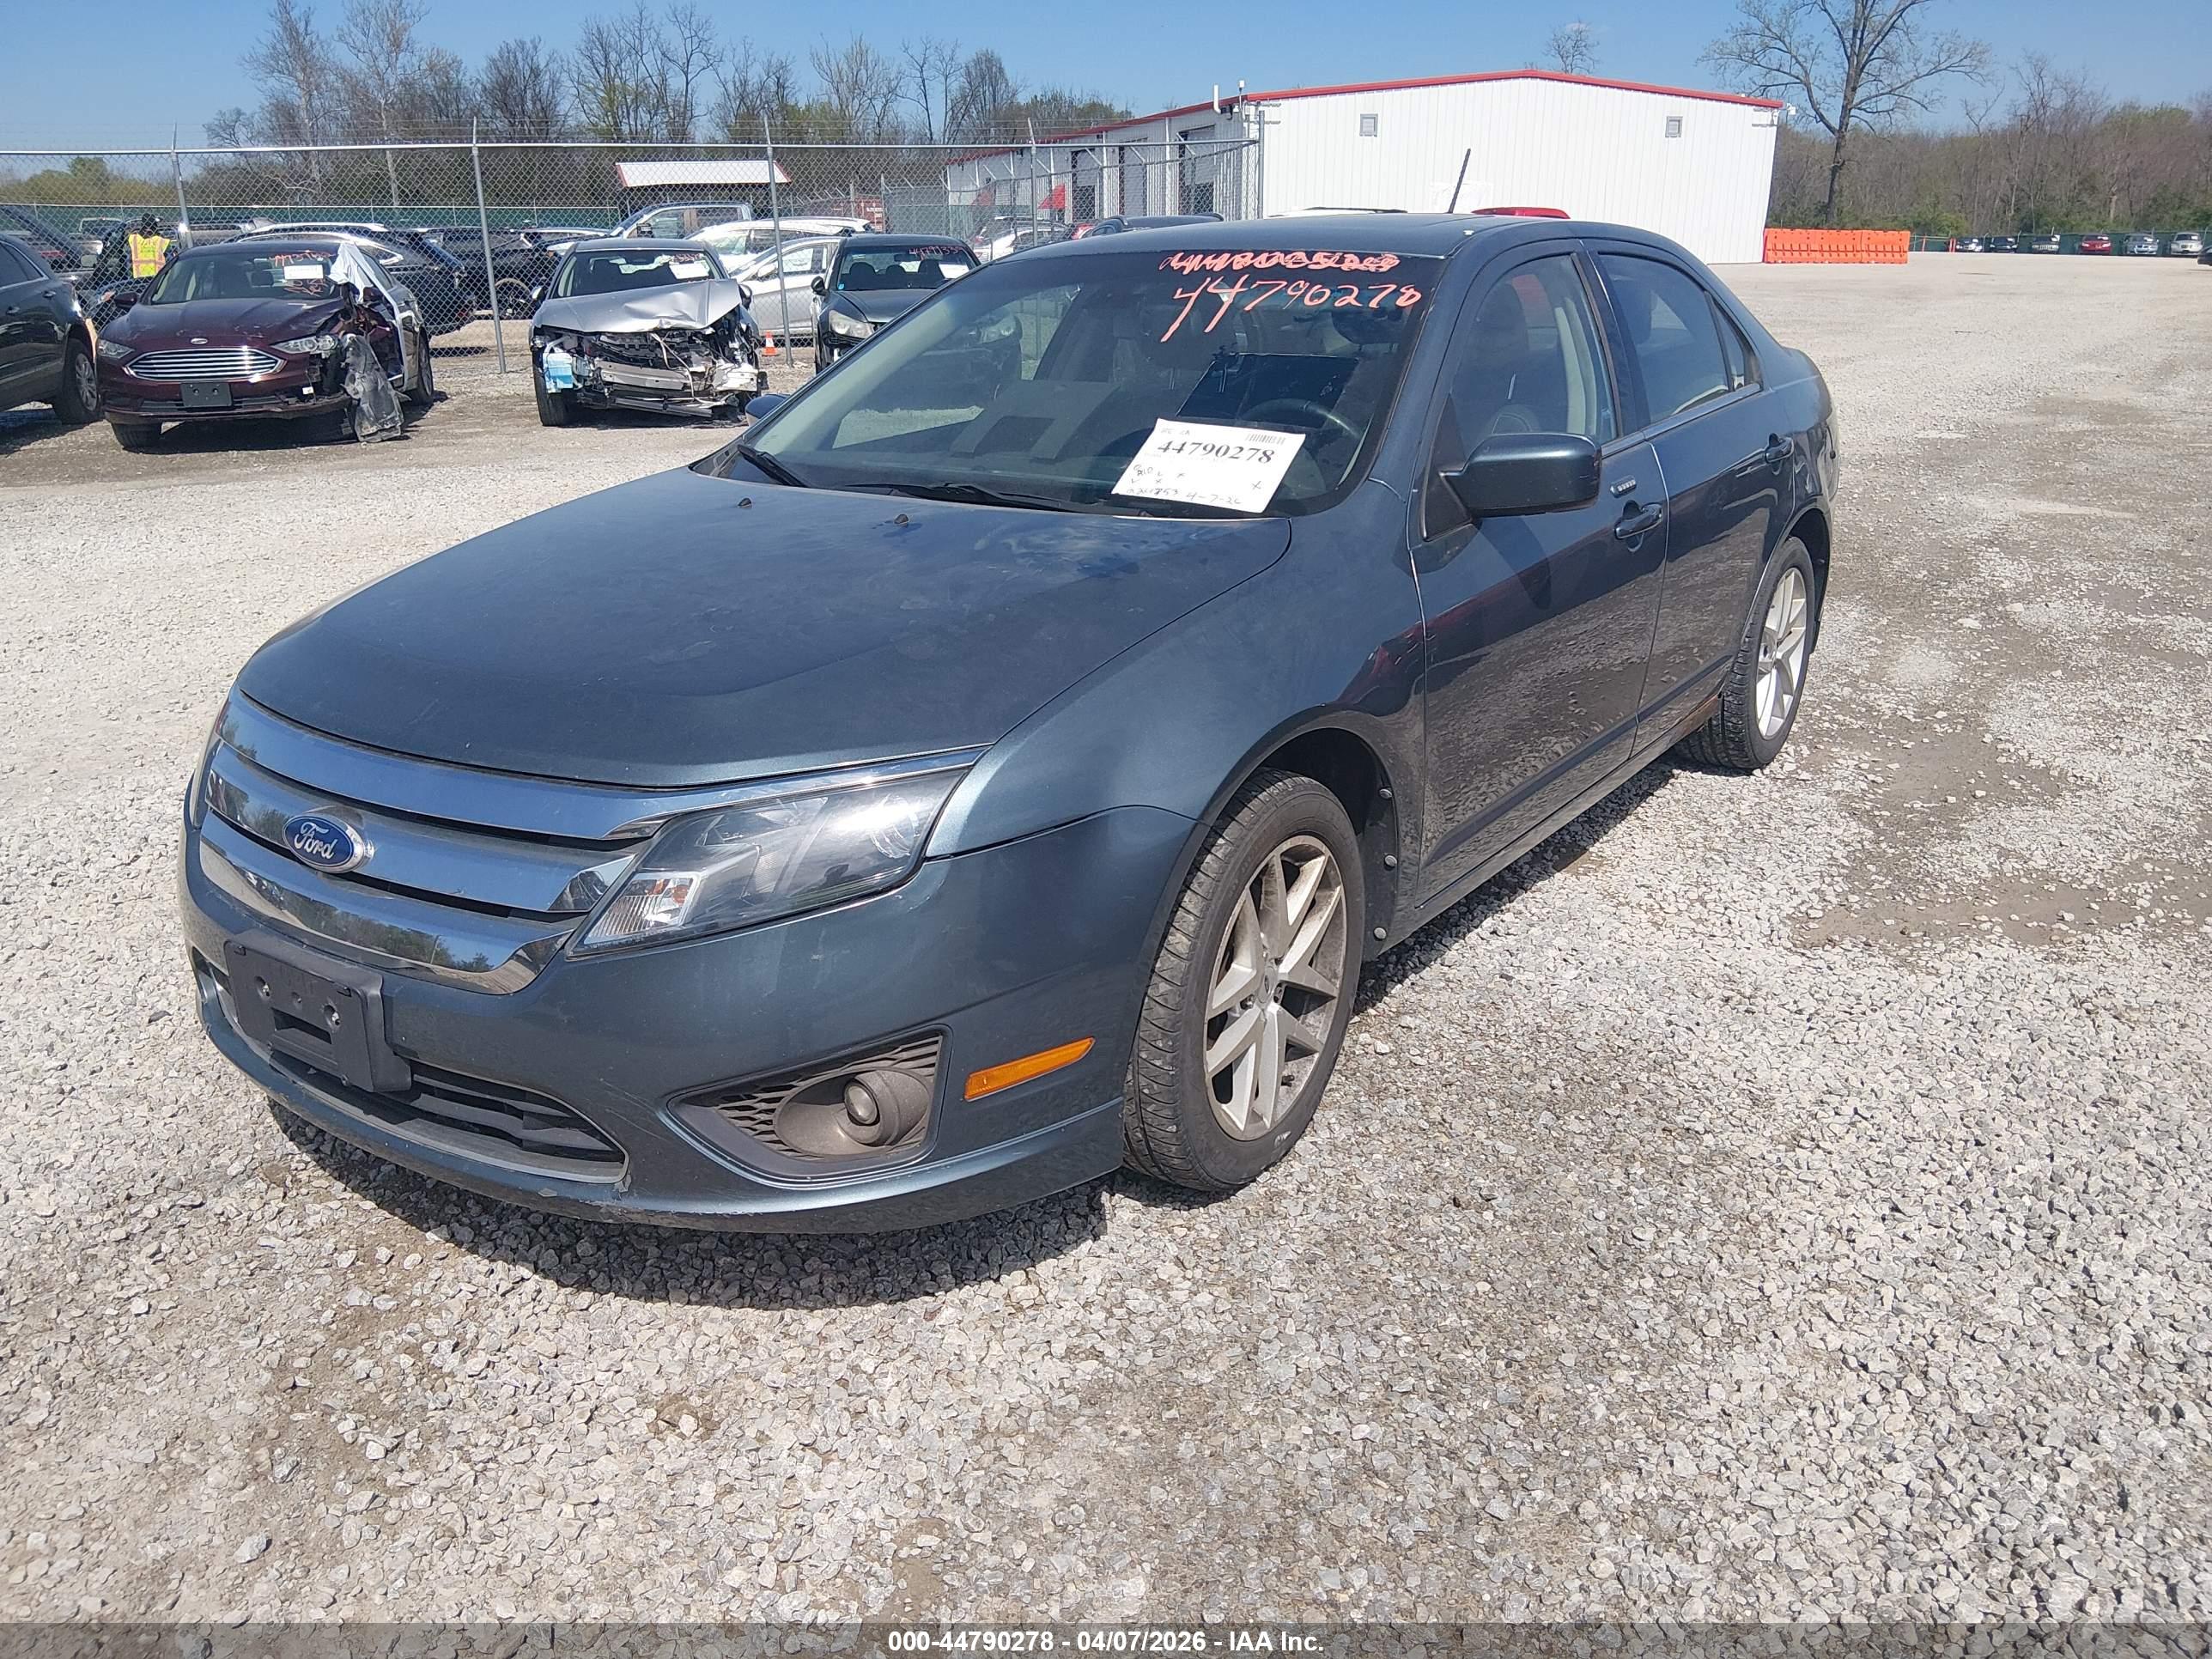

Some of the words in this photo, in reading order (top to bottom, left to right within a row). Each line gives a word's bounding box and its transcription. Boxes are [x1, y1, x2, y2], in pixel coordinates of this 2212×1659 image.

[1161, 274, 1422, 343] 44790278
[1157, 440, 1275, 464] 44790278
[294, 821, 338, 860] Ford
